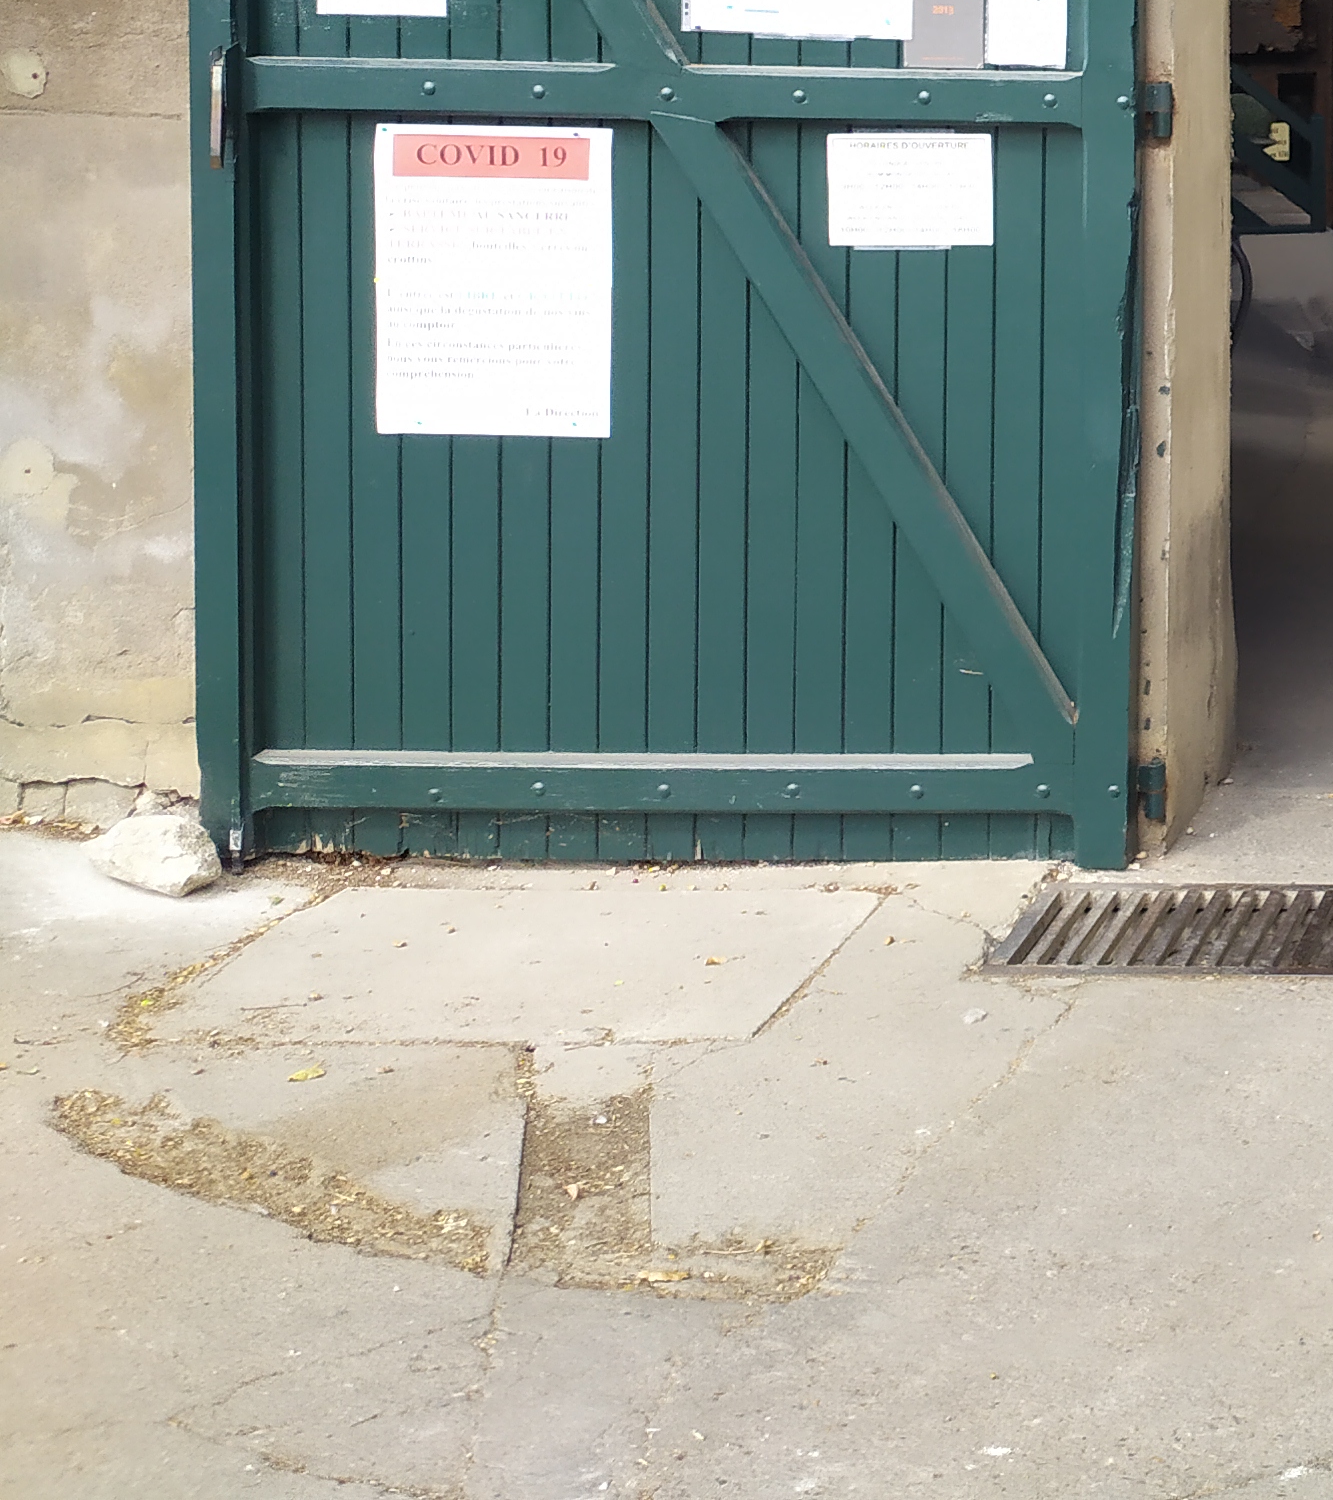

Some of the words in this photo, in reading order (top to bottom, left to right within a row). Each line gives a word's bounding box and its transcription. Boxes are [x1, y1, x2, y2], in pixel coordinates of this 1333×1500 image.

[849, 140, 900, 150] HORAIRES
[901, 140, 970, 150] D'OUVERTURE
[416, 143, 521, 168] COVID
[539, 145, 568, 168] 19
